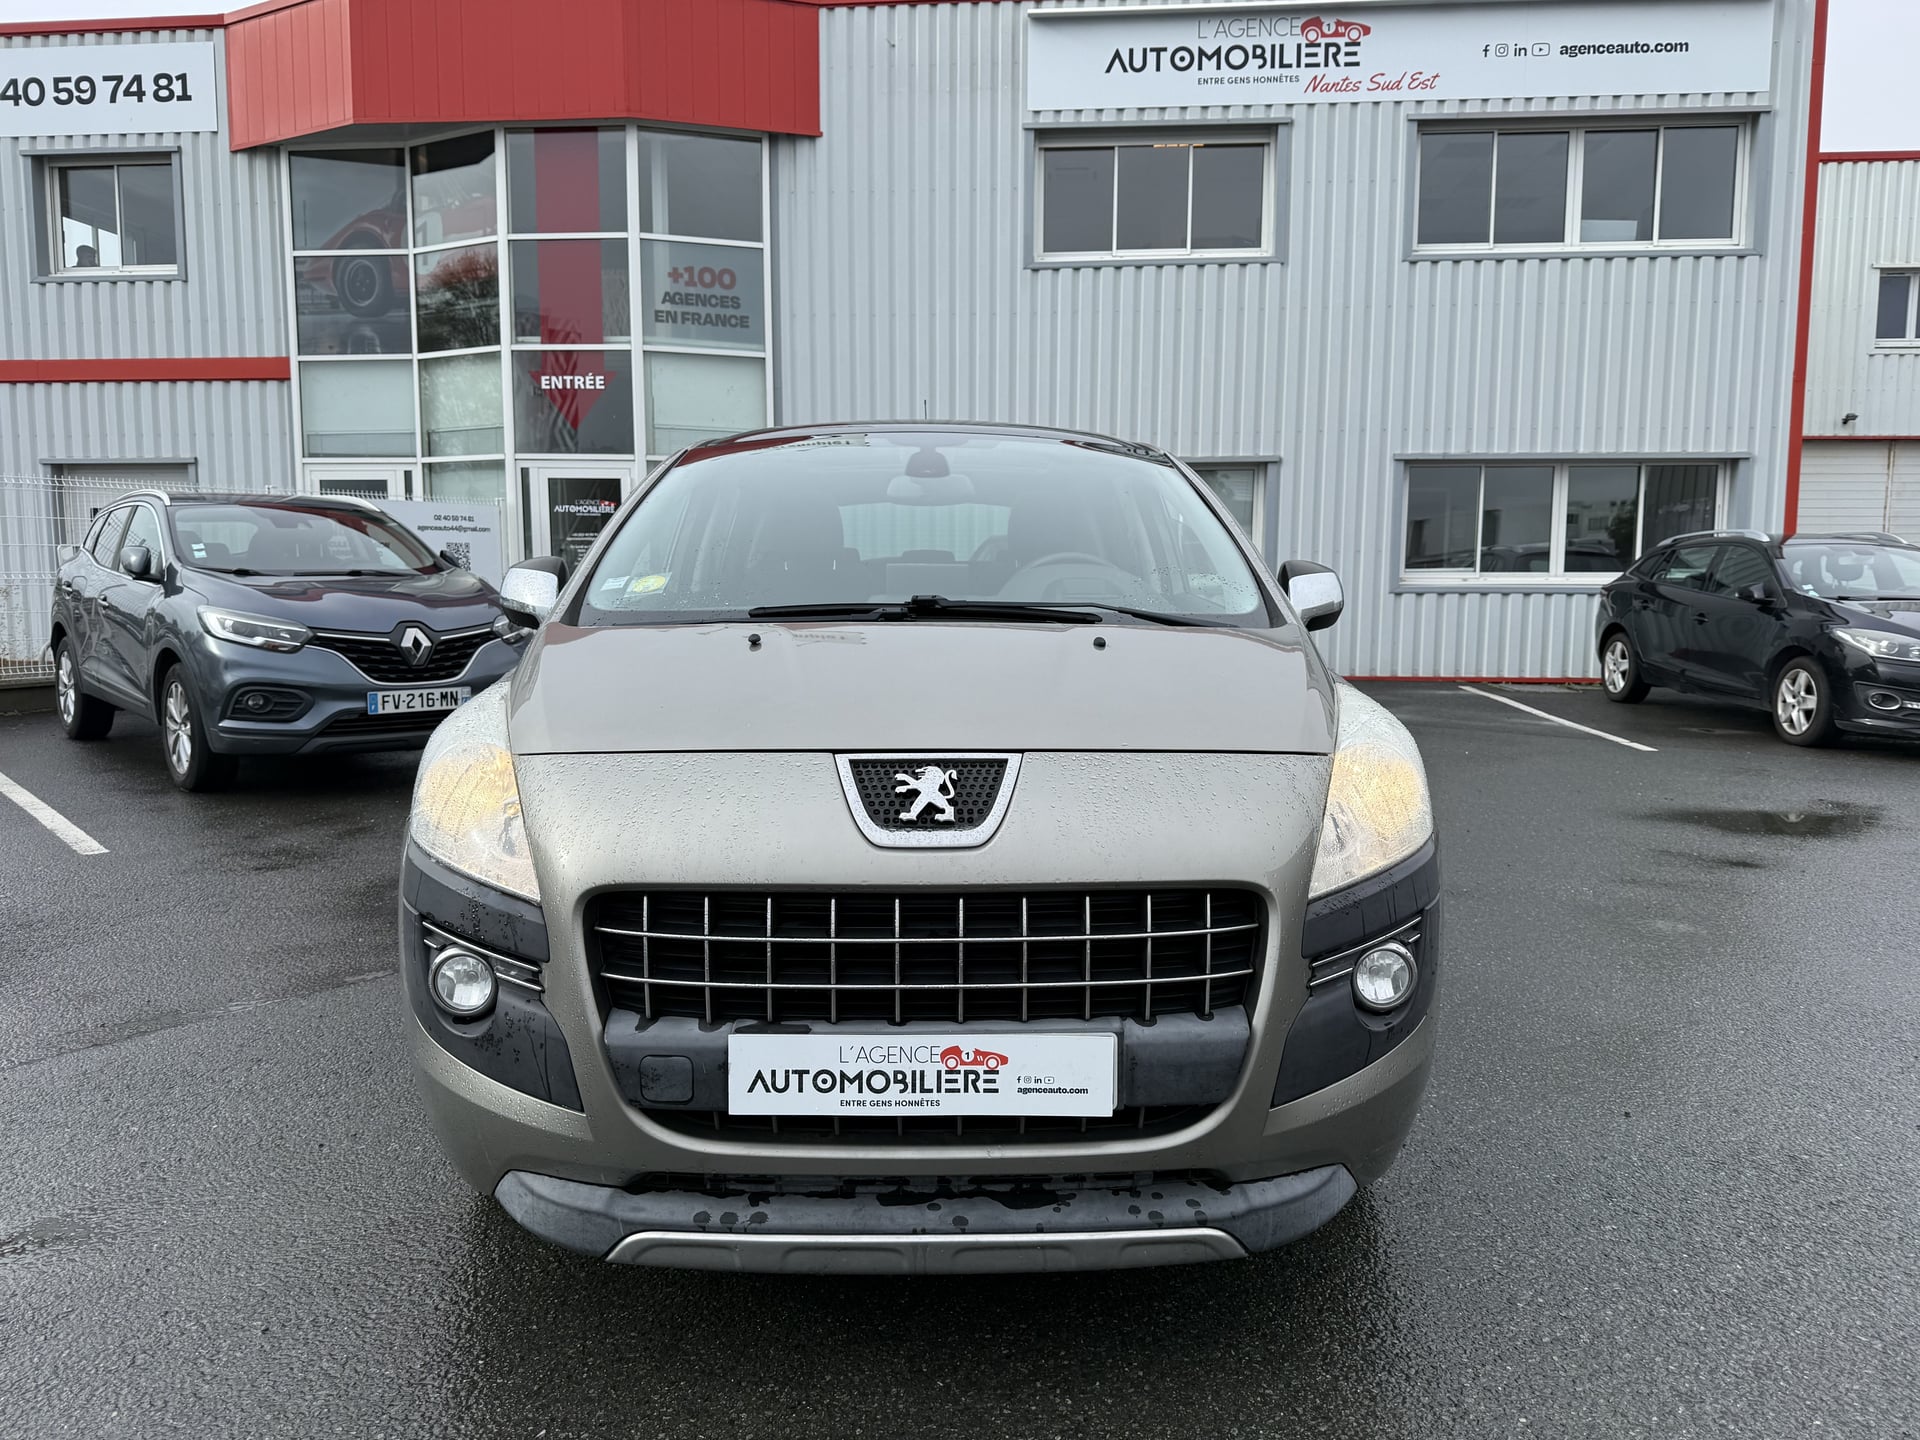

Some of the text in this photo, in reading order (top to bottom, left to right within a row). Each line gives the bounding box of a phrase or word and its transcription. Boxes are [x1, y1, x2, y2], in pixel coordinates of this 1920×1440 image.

[1198, 16, 1301, 39] L'AGENCE
[1559, 41, 1689, 58] agenceauto.com
[1198, 73, 1300, 85] ENTRE GENS HONNÊTES
[1304, 71, 1440, 94] Nantes Sud Est
[0, 72, 192, 107] 40 59 74 81
[667, 266, 737, 290] +100
[661, 291, 741, 310] AGENCES
[654, 310, 750, 329] EN FRANCE
[541, 372, 605, 390] ENTRÉE
[382, 690, 459, 711] FV-216-MN
[839, 1046, 941, 1064] L'AGENCE
[1016, 1086, 1089, 1096] agenceauto.com
[840, 1097, 941, 1107] ENTRE GENS HONNÊTES
